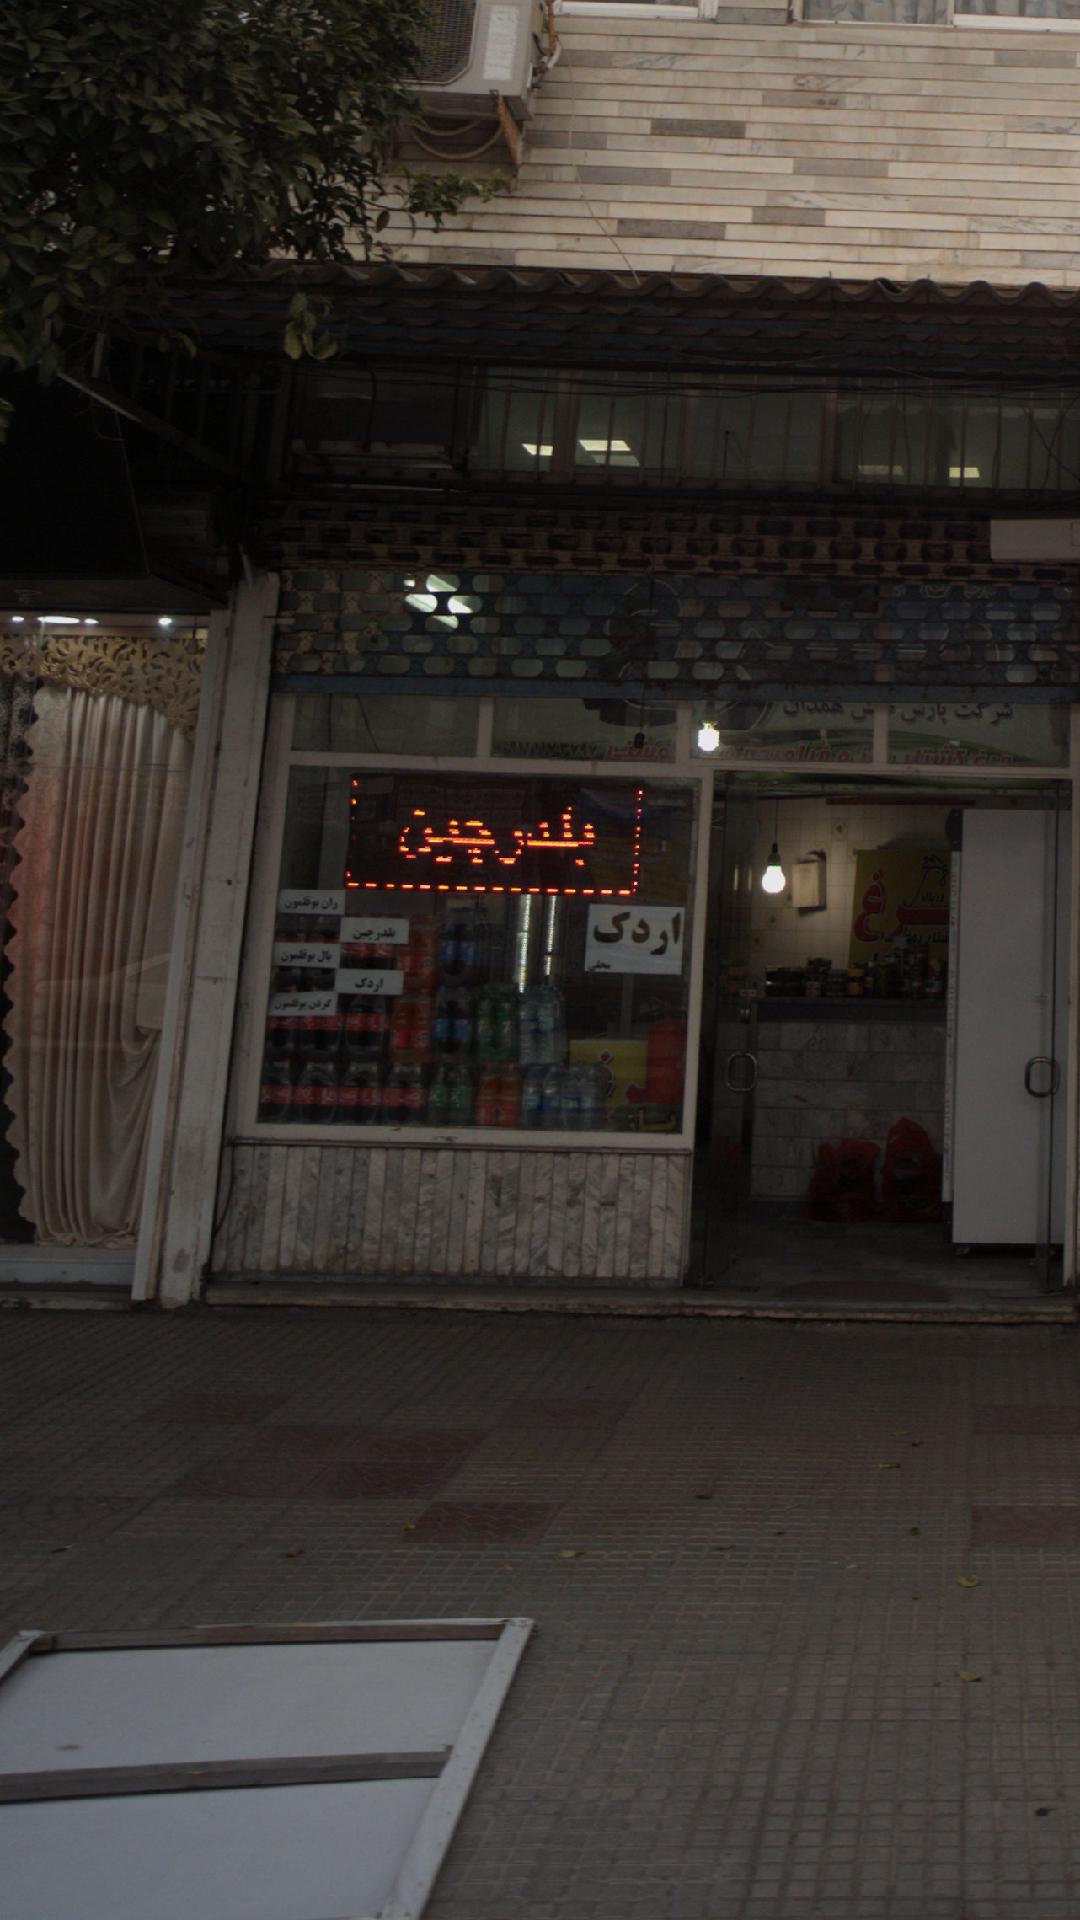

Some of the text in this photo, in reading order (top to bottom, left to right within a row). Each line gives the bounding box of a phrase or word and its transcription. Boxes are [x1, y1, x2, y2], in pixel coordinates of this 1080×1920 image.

[398, 804, 598, 867] بلدرچین
[593, 911, 682, 956] اردک
[354, 977, 384, 993] اردک
